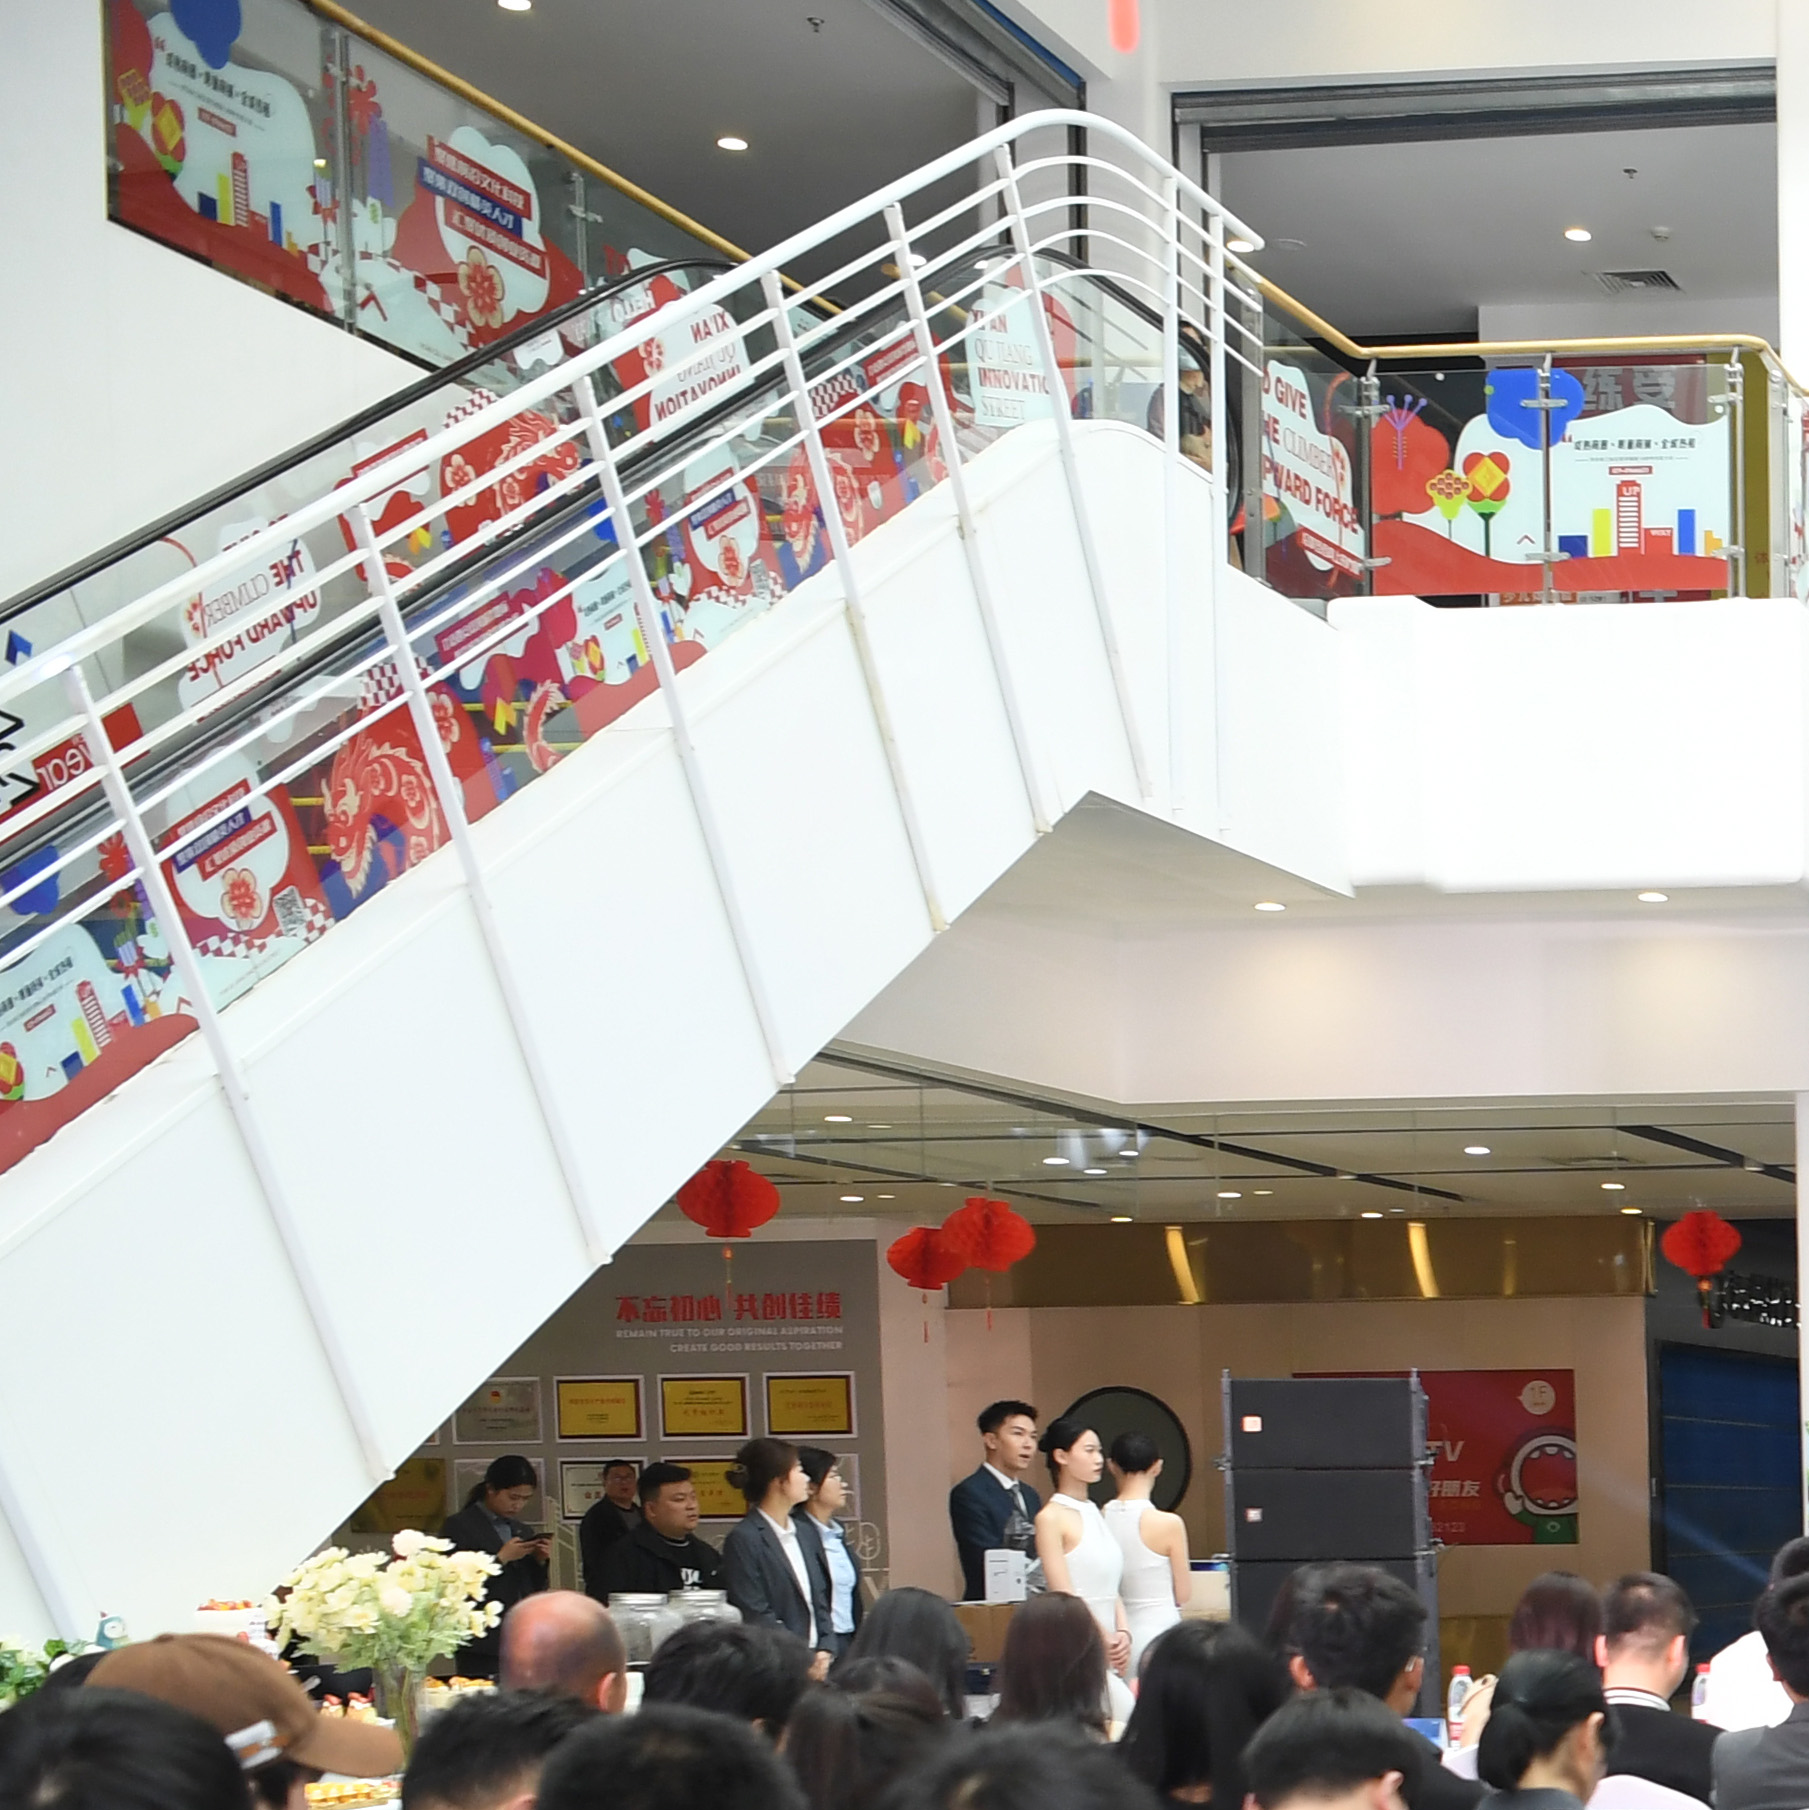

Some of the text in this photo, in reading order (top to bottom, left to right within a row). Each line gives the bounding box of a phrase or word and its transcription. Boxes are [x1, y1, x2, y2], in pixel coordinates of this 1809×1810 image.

[616, 1291, 843, 1323] 不忘初心 共创佳绩
[616, 1325, 845, 1339] REMAIN TRUE TO OUR ORIGINAL ASPIRATION
[668, 1340, 843, 1353] CREATE GOOD RESULTS TOGETHER
